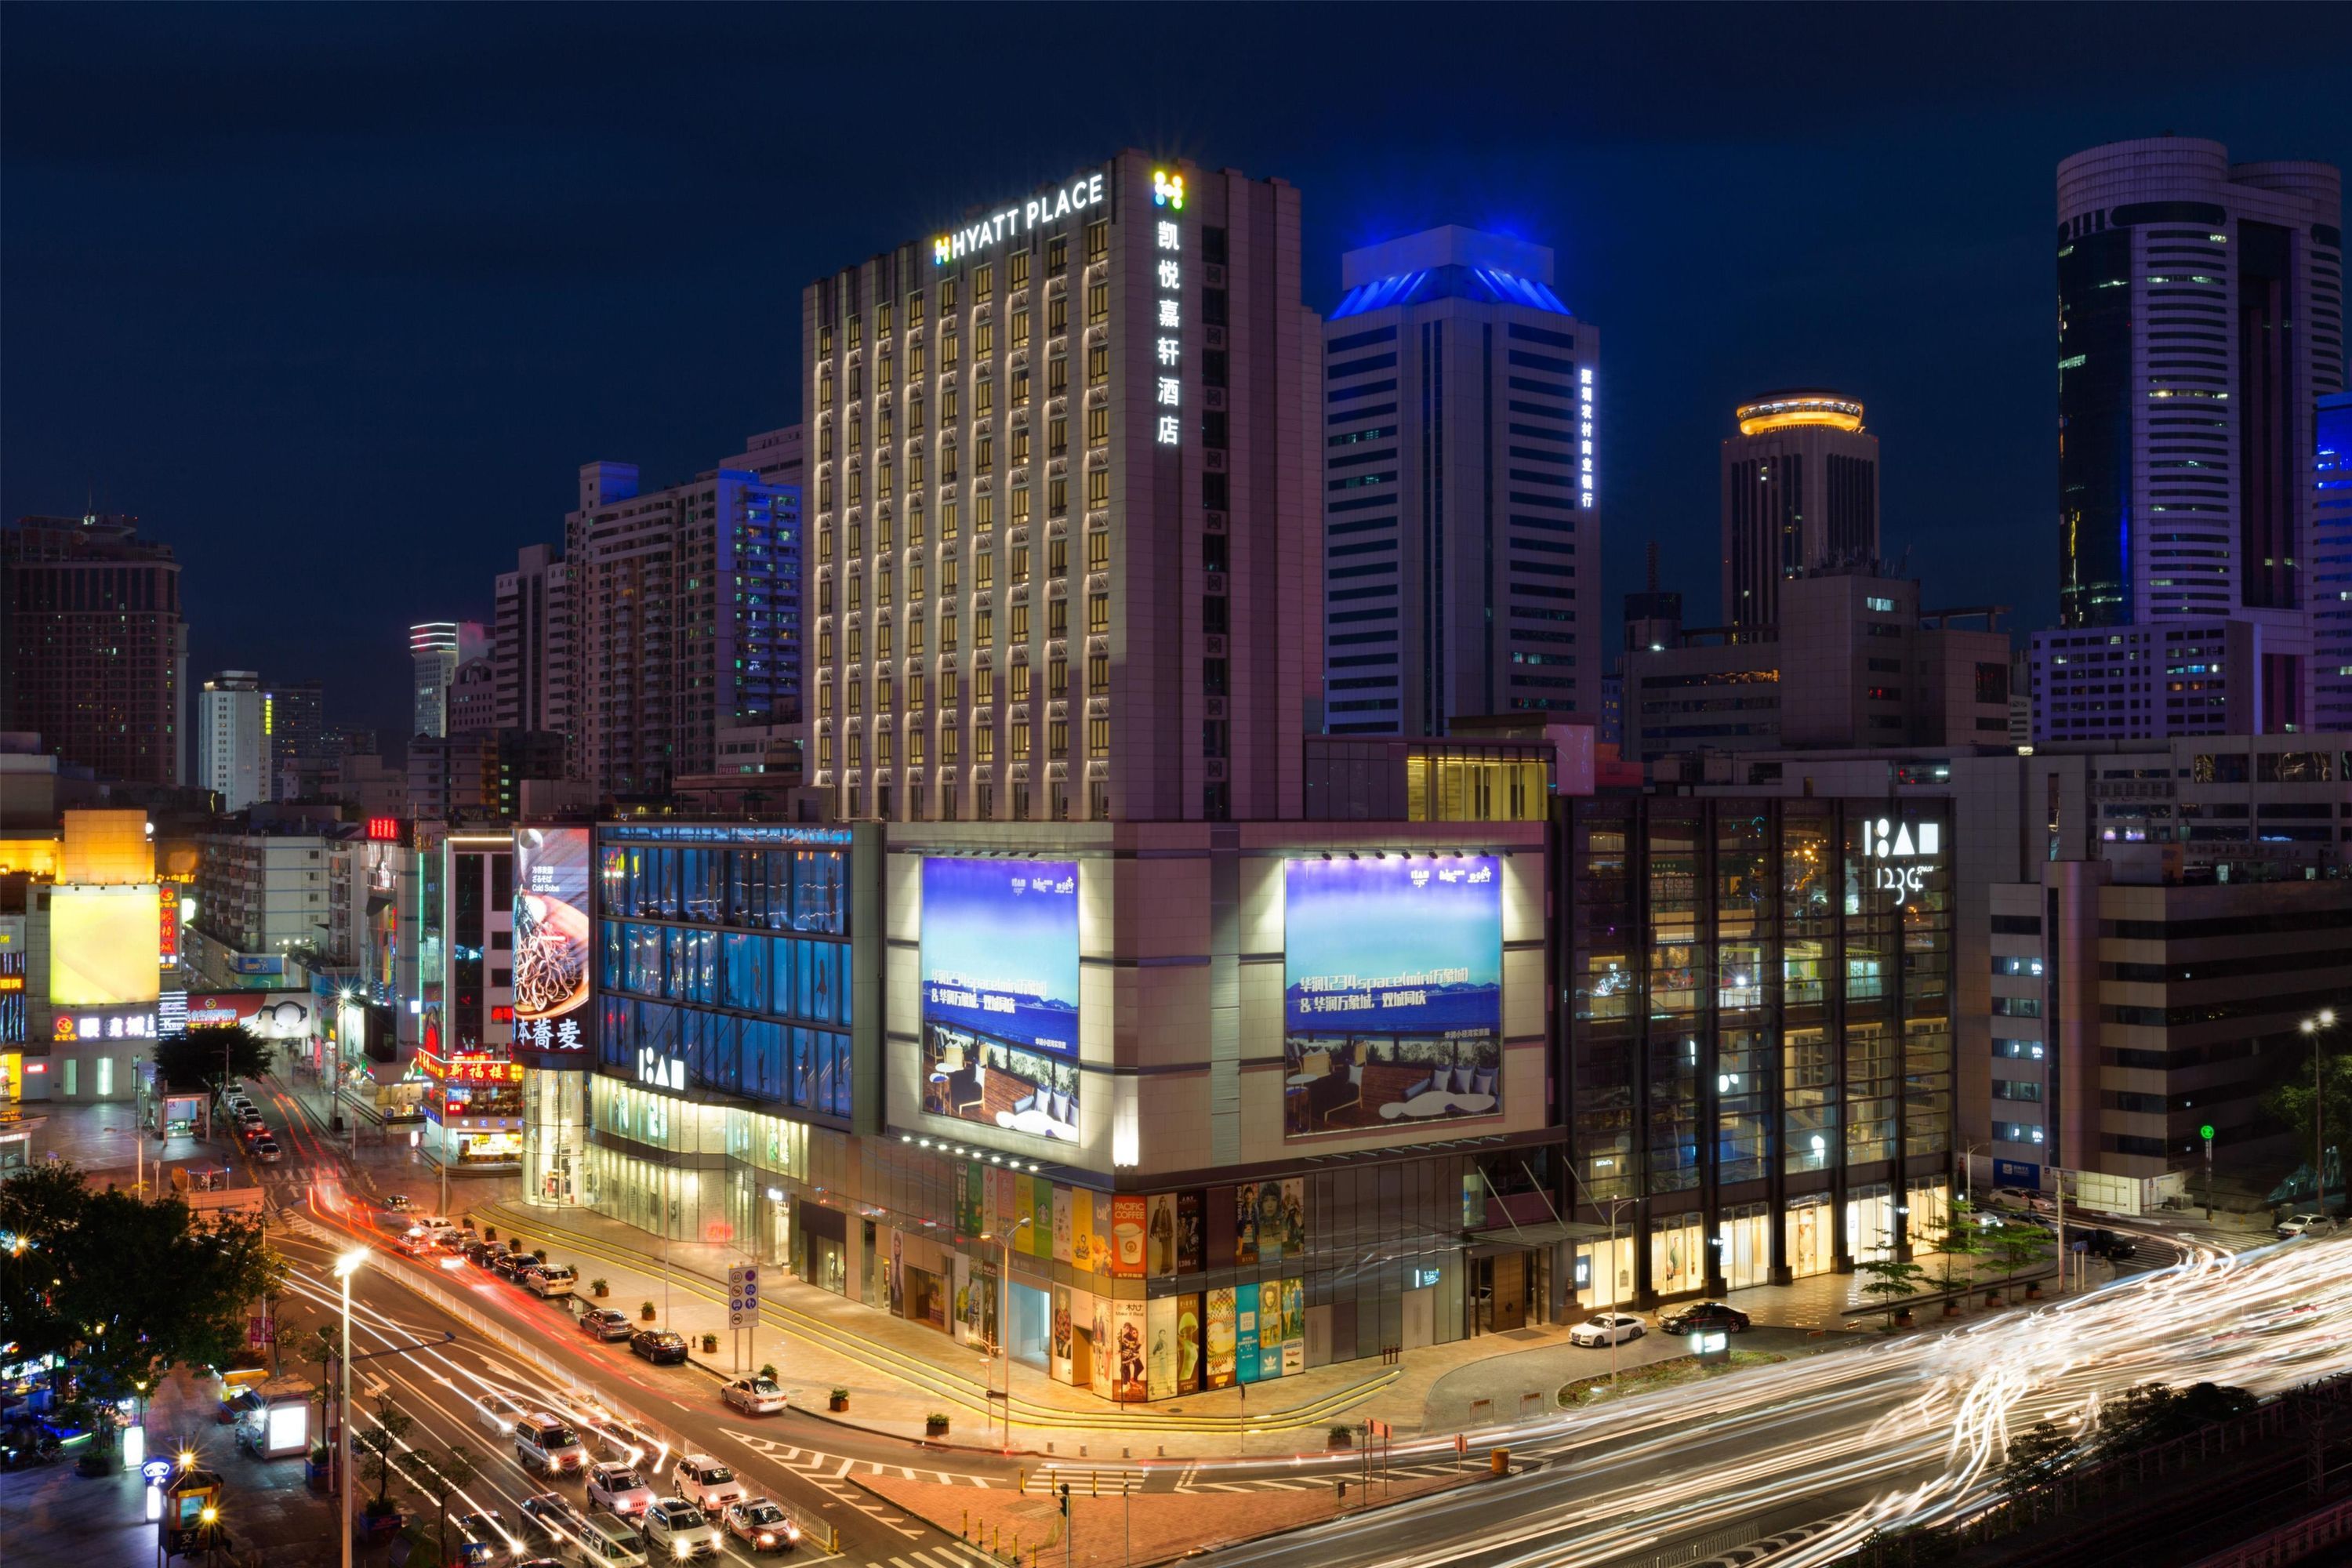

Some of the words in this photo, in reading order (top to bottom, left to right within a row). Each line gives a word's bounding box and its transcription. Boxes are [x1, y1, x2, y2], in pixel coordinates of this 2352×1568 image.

[952, 208, 1019, 260] HYATT
[1027, 173, 1103, 230] PLACE
[1157, 220, 1180, 445] 凯悦嘉轩酒店
[1877, 867, 1924, 906] 1234
[1300, 997, 1312, 1013] &
[1382, 989, 1428, 1008] 双城同庆
[1114, 1203, 1145, 1211] PACIFIC
